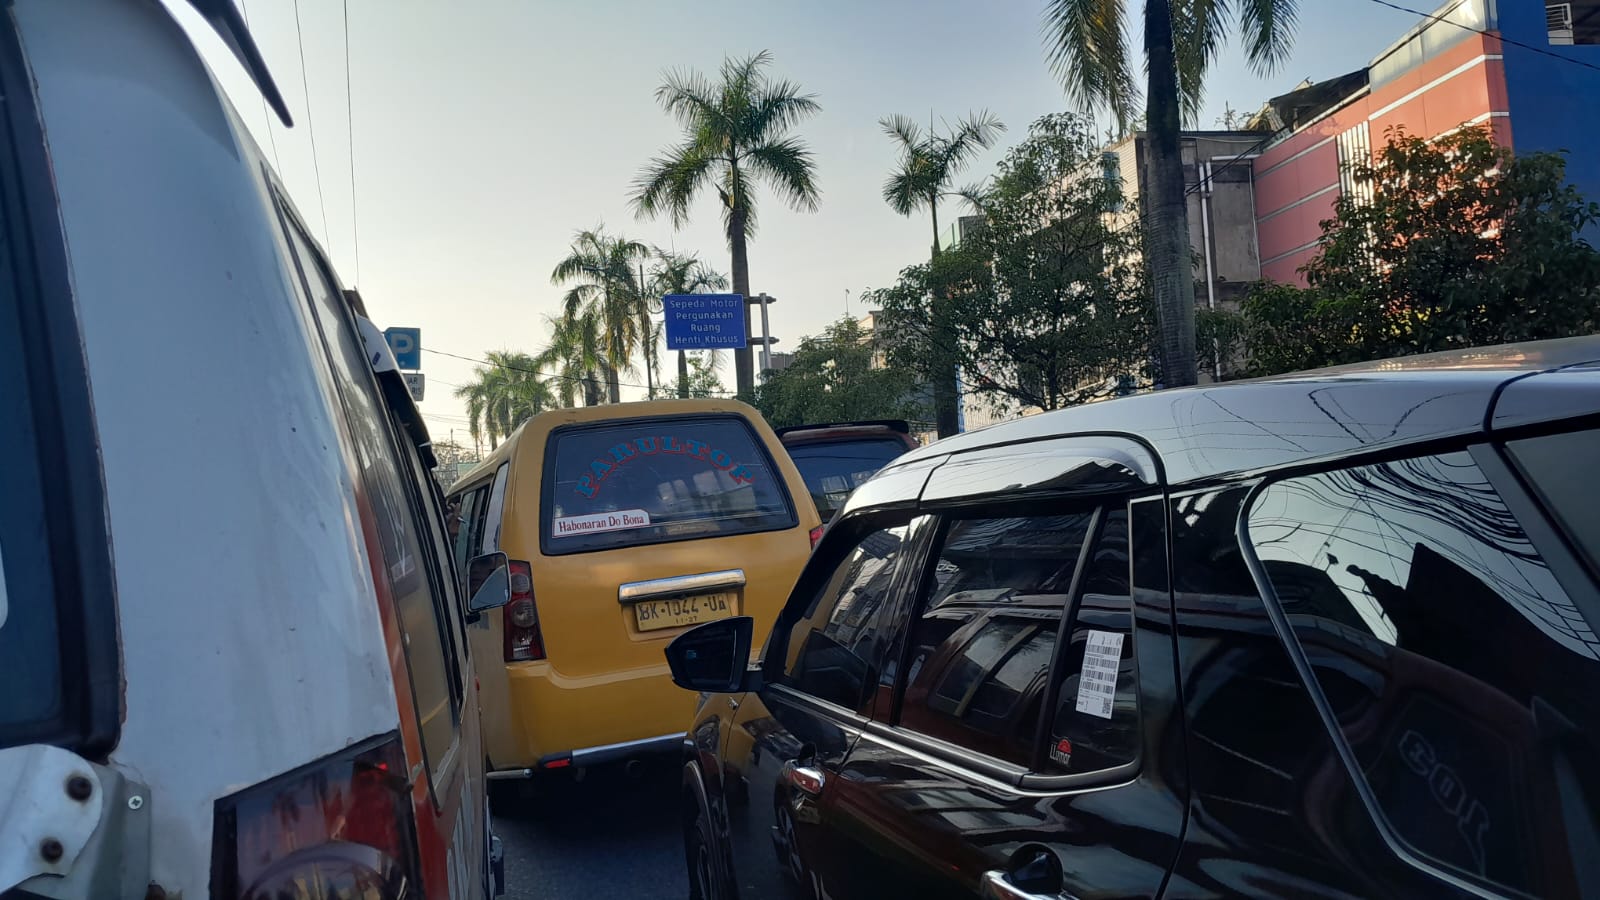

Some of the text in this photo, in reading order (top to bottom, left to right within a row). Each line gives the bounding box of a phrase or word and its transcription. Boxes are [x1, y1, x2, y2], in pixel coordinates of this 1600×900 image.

[670, 300, 737, 309] Sepeda Motor
[676, 312, 734, 322] Pergunakan
[690, 324, 720, 333] Ruang
[676, 336, 738, 344] Henti Khusus
[390, 334, 414, 360] P
[575, 436, 755, 499] PARULTOP
[558, 514, 645, 533] Habonaran Do Bona
